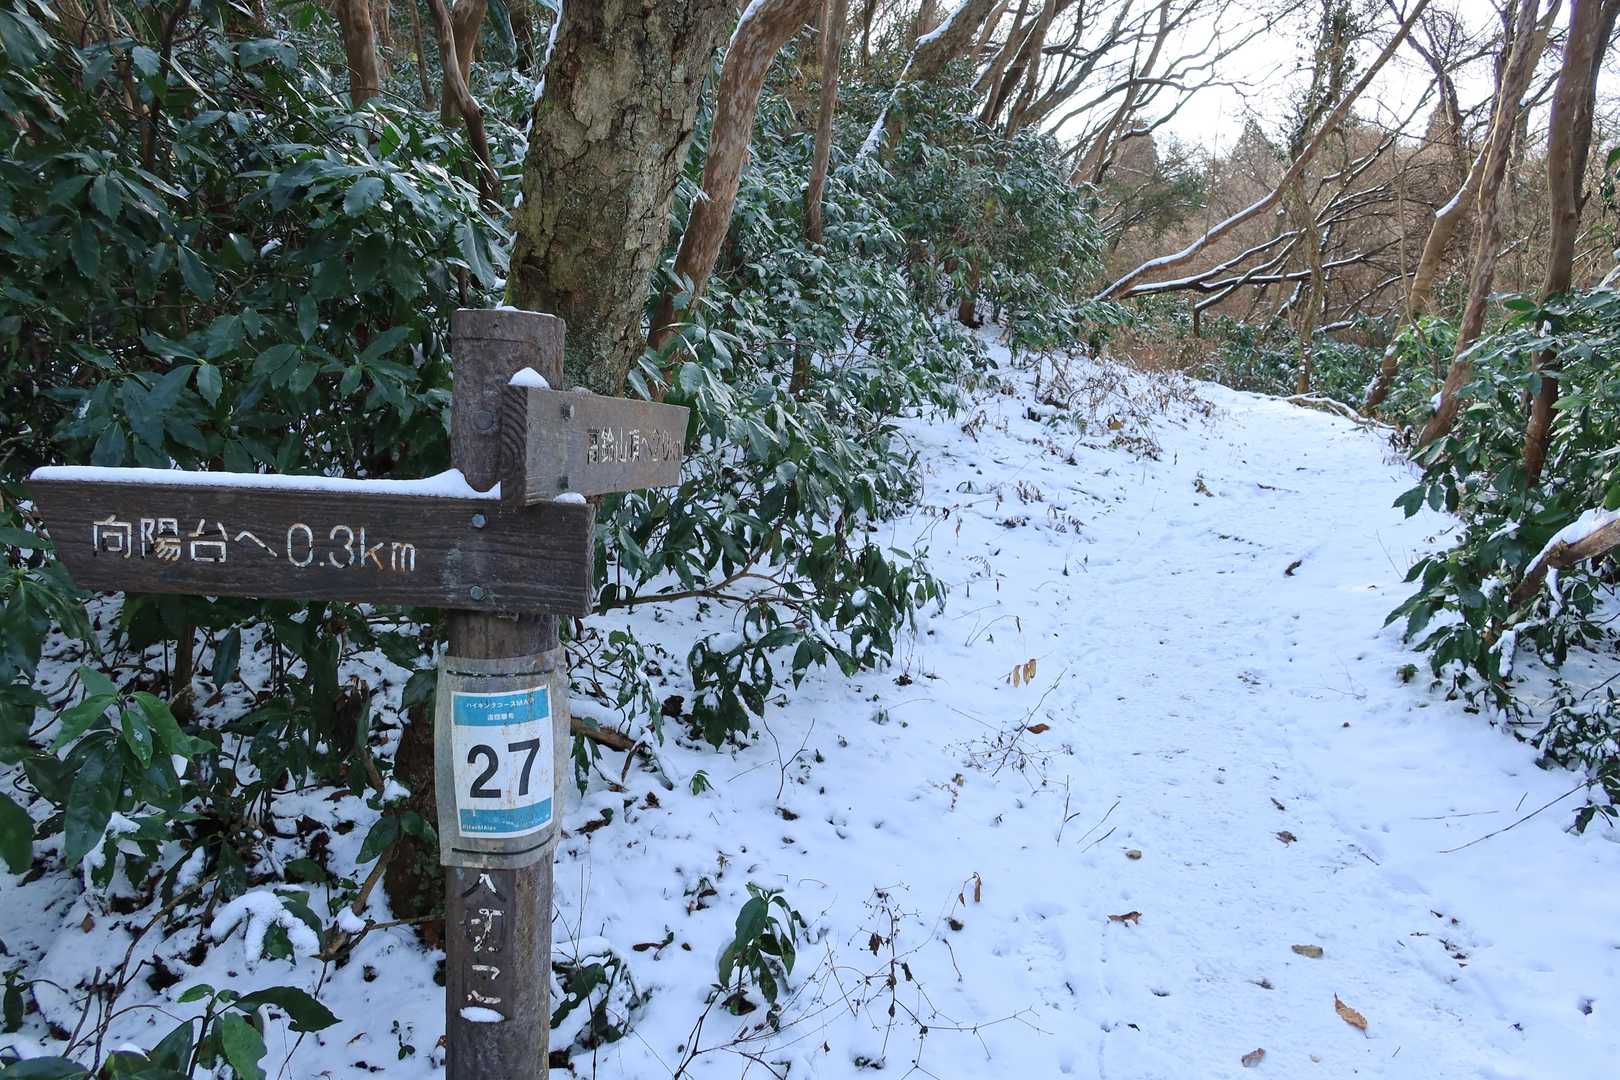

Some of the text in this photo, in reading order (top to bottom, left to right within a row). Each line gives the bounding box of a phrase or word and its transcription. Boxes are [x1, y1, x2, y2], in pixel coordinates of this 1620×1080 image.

[92, 513, 417, 573] 向陽台へ0.3km
[467, 738, 540, 798] 27
